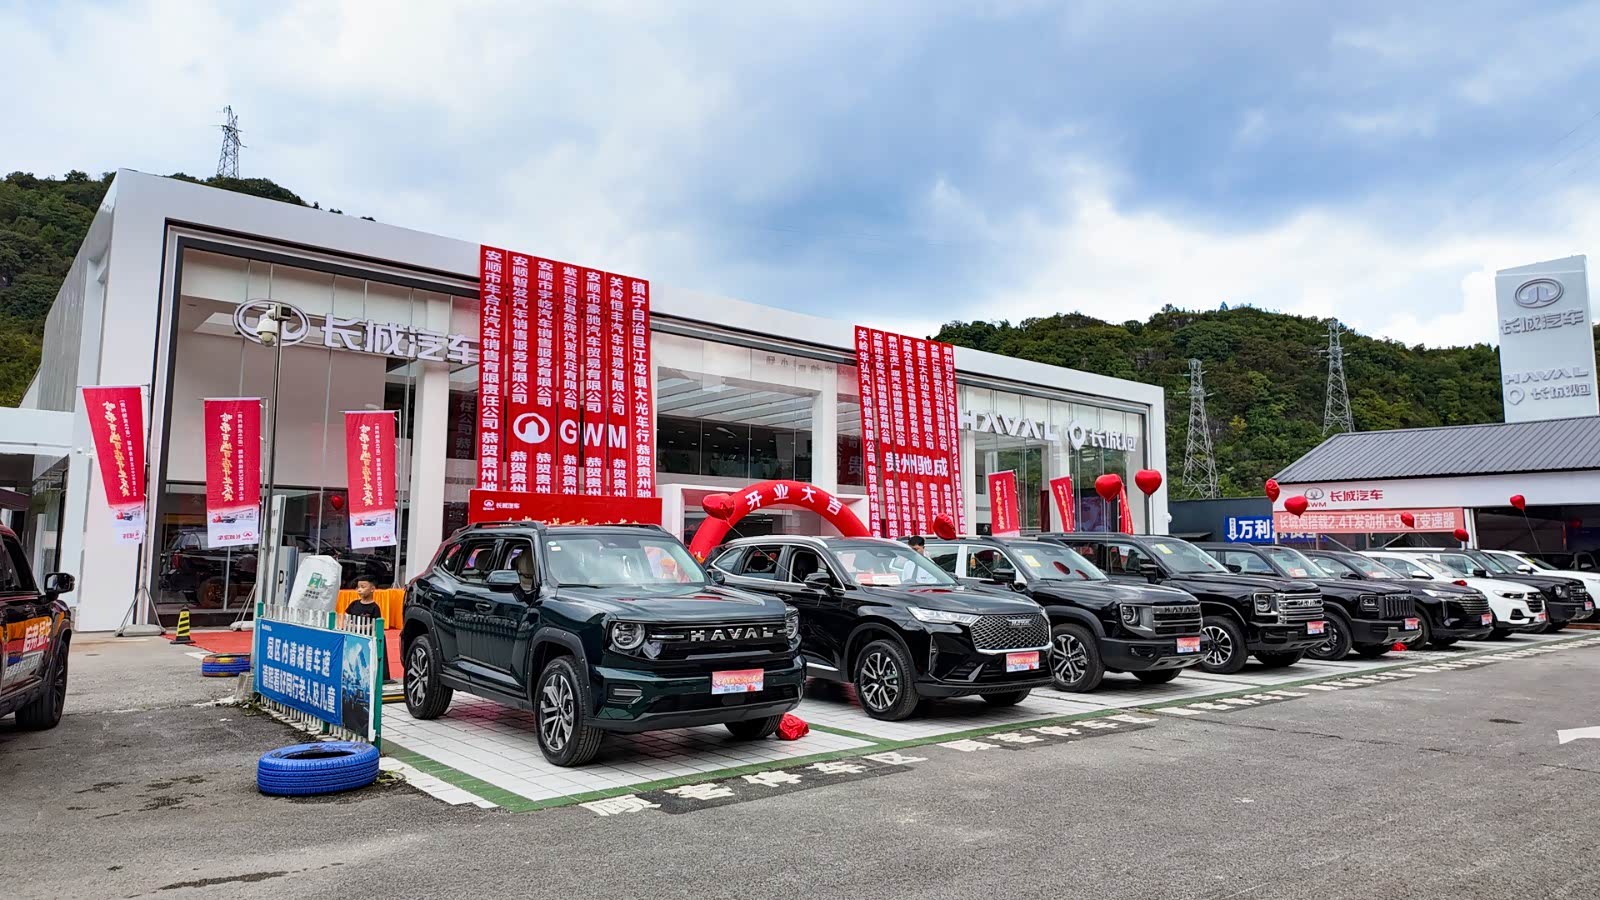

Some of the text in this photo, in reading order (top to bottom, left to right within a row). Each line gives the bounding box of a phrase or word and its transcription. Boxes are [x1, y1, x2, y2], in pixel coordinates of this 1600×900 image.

[1500, 310, 1584, 335] 长城汽车
[320, 313, 480, 365] 长城汽车
[1504, 366, 1589, 384] HAVAL
[560, 419, 626, 449] GWM
[958, 410, 1060, 441] HAVAL
[885, 452, 948, 477] 贵州驰成
[745, 483, 843, 516] 开业大吉
[1330, 490, 1383, 502] 长城汽车
[1279, 512, 1455, 530] 长城炮搭载2.4T发动机+9T变速器
[690, 627, 774, 642] HAVAL
